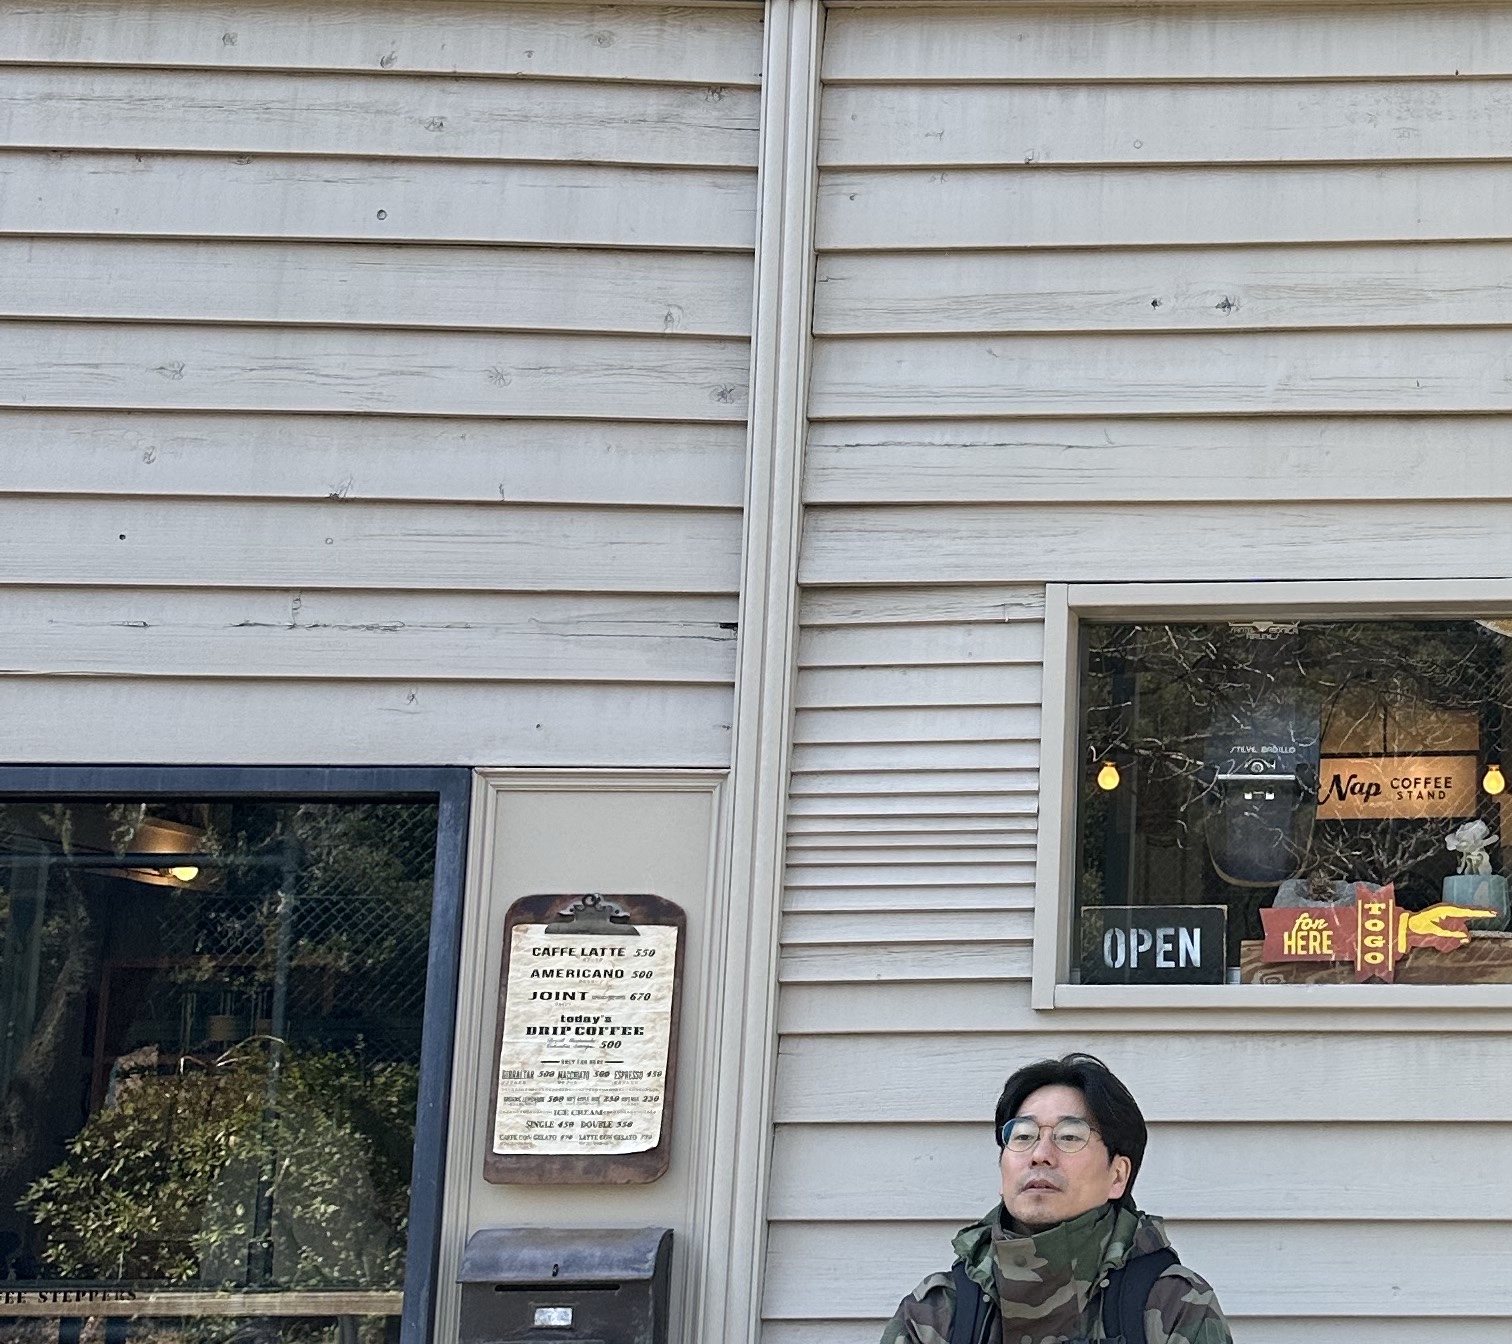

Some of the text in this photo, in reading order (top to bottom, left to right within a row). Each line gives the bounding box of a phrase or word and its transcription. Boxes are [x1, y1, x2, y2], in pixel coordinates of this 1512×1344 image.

[1317, 774, 1453, 804] Nap COFFEE
[1397, 791, 1446, 800] STAND
[1284, 930, 1333, 954] HERE
[532, 947, 577, 956] CAFFE
[581, 948, 626, 956] LATTE
[1104, 928, 1200, 968] OPEN
[530, 969, 624, 978] AMERICANO
[528, 992, 589, 1000] JOINT
[630, 993, 651, 1001] 670
[526, 1026, 644, 1035] DRIP COFFEE
[600, 1040, 622, 1048] 500
